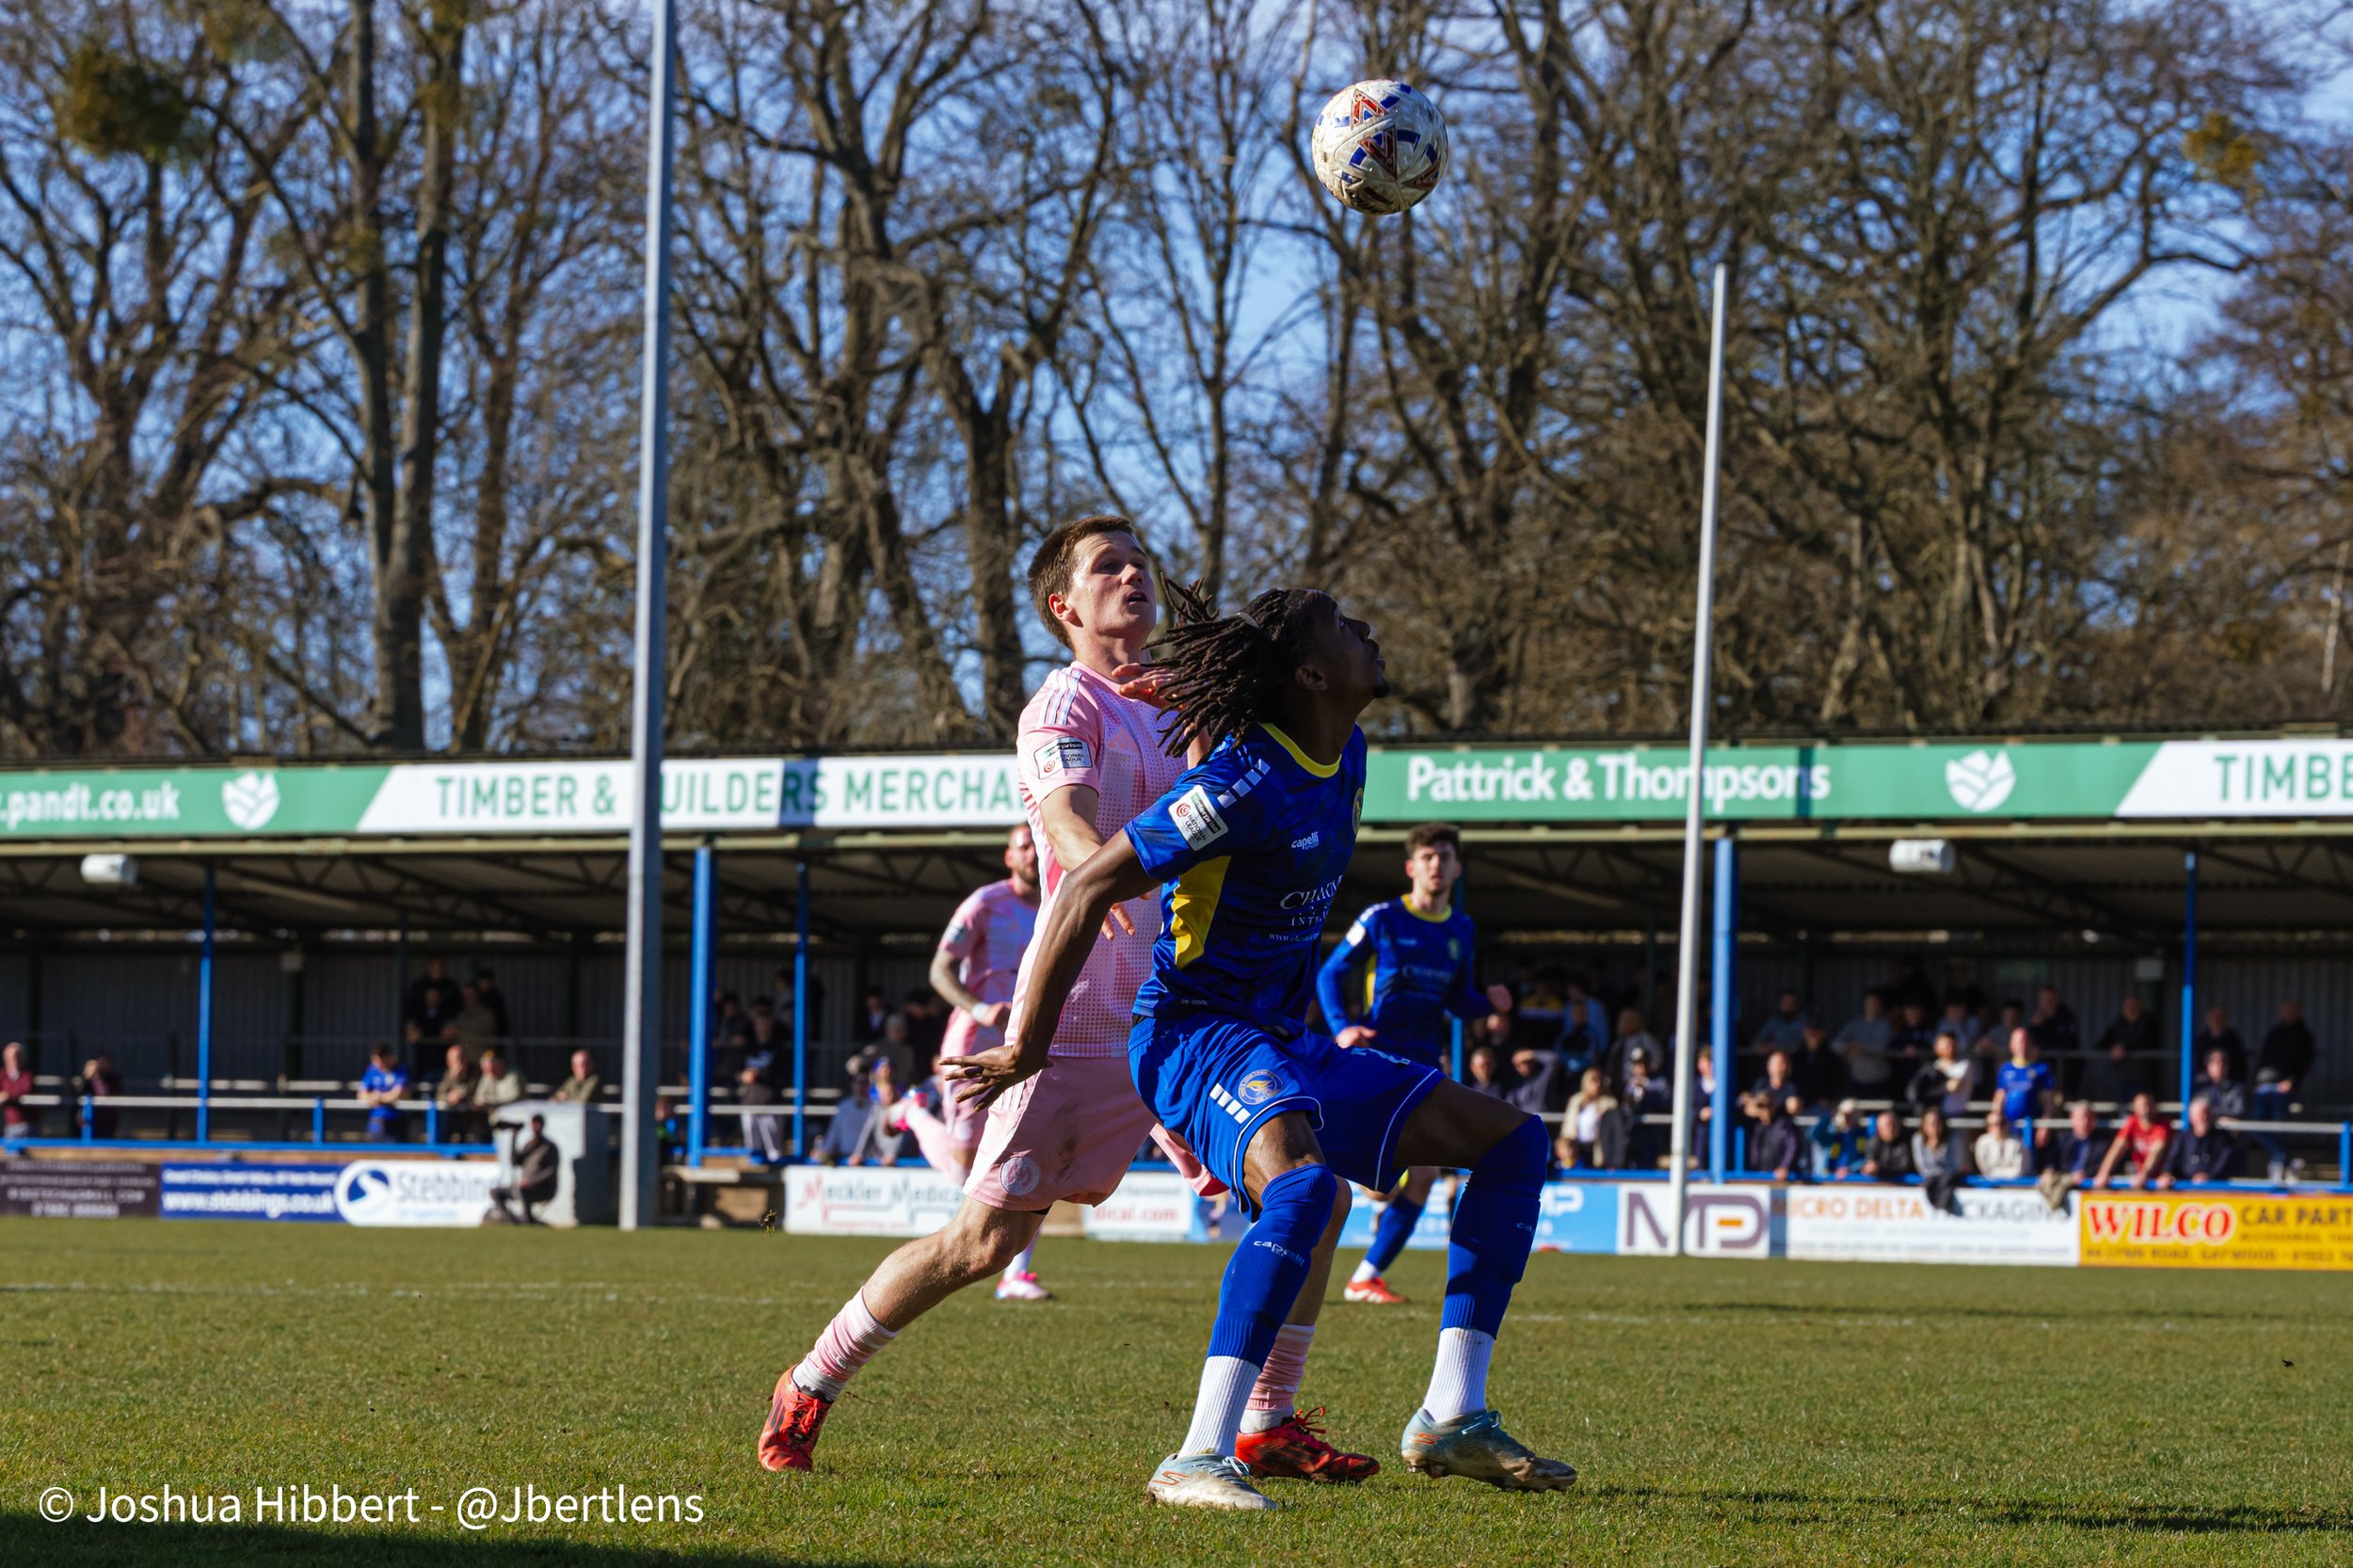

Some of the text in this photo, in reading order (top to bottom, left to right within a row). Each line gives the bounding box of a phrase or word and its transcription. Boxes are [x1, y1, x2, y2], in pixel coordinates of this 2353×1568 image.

[0, 780, 181, 830] .pandt.co.uk
[435, 768, 1024, 817] TIMBER & UILDERS MERCHA
[1407, 752, 1832, 815] Pattrick & Thompsons
[888, 1174, 963, 1207] Medica
[1855, 1196, 1926, 1220] DELTA
[2087, 1203, 2233, 1240] WILCO
[2241, 1205, 2286, 1225] CAR
